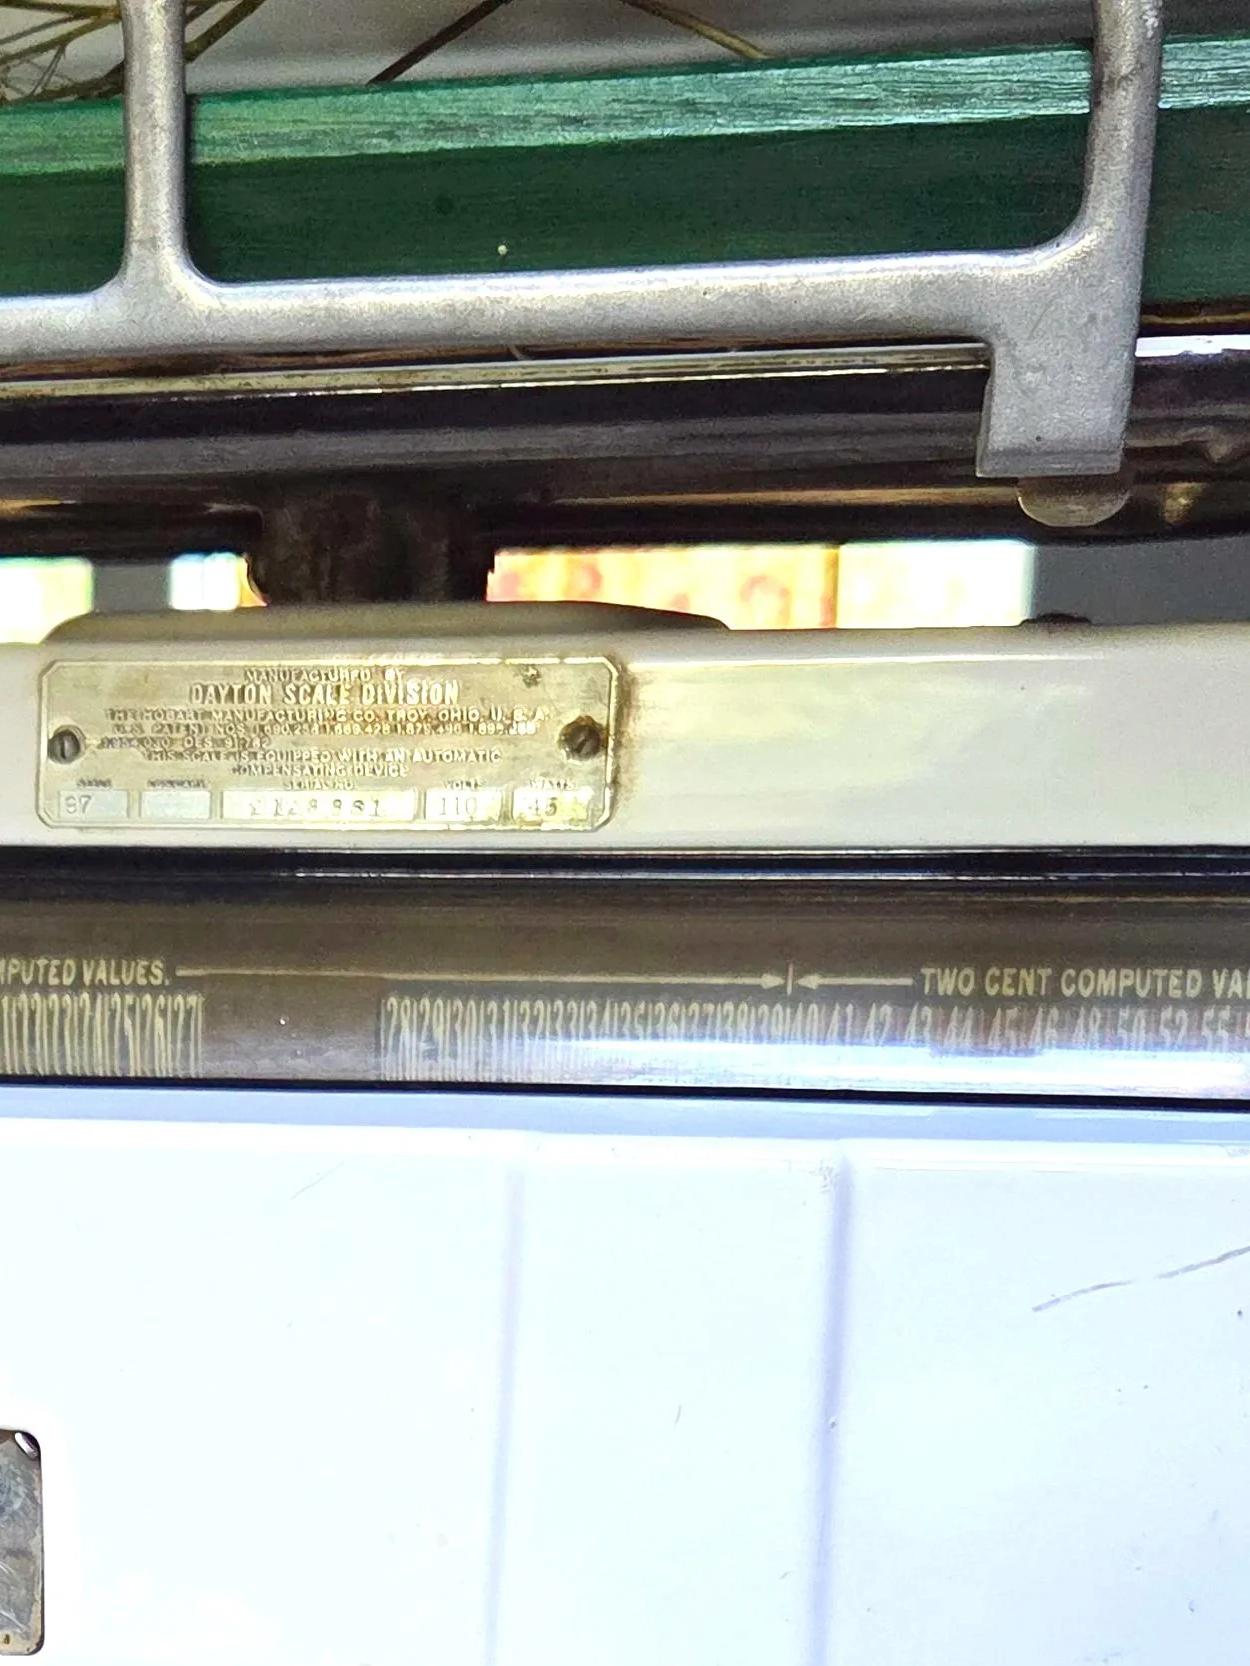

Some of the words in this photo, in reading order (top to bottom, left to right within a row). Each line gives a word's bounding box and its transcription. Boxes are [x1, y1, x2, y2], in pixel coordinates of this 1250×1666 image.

[384, 667, 406, 682] BY
[190, 682, 272, 705] DAYTON
[284, 682, 351, 705] SCALE
[361, 680, 459, 705] DIVISION
[140, 708, 205, 722] HOBART
[183, 750, 227, 763] SCALE
[257, 748, 331, 764] EQUIPPED
[338, 748, 377, 763] WITH
[384, 748, 407, 763] AN
[413, 748, 502, 763] AUTOMATIC
[231, 762, 347, 777] COMPENSATING
[354, 762, 409, 777] DEVICE
[439, 797, 477, 817] 110
[920, 967, 976, 996] TWO
[985, 967, 1052, 997] CENT
[1061, 967, 1202, 998] COMPUTED
